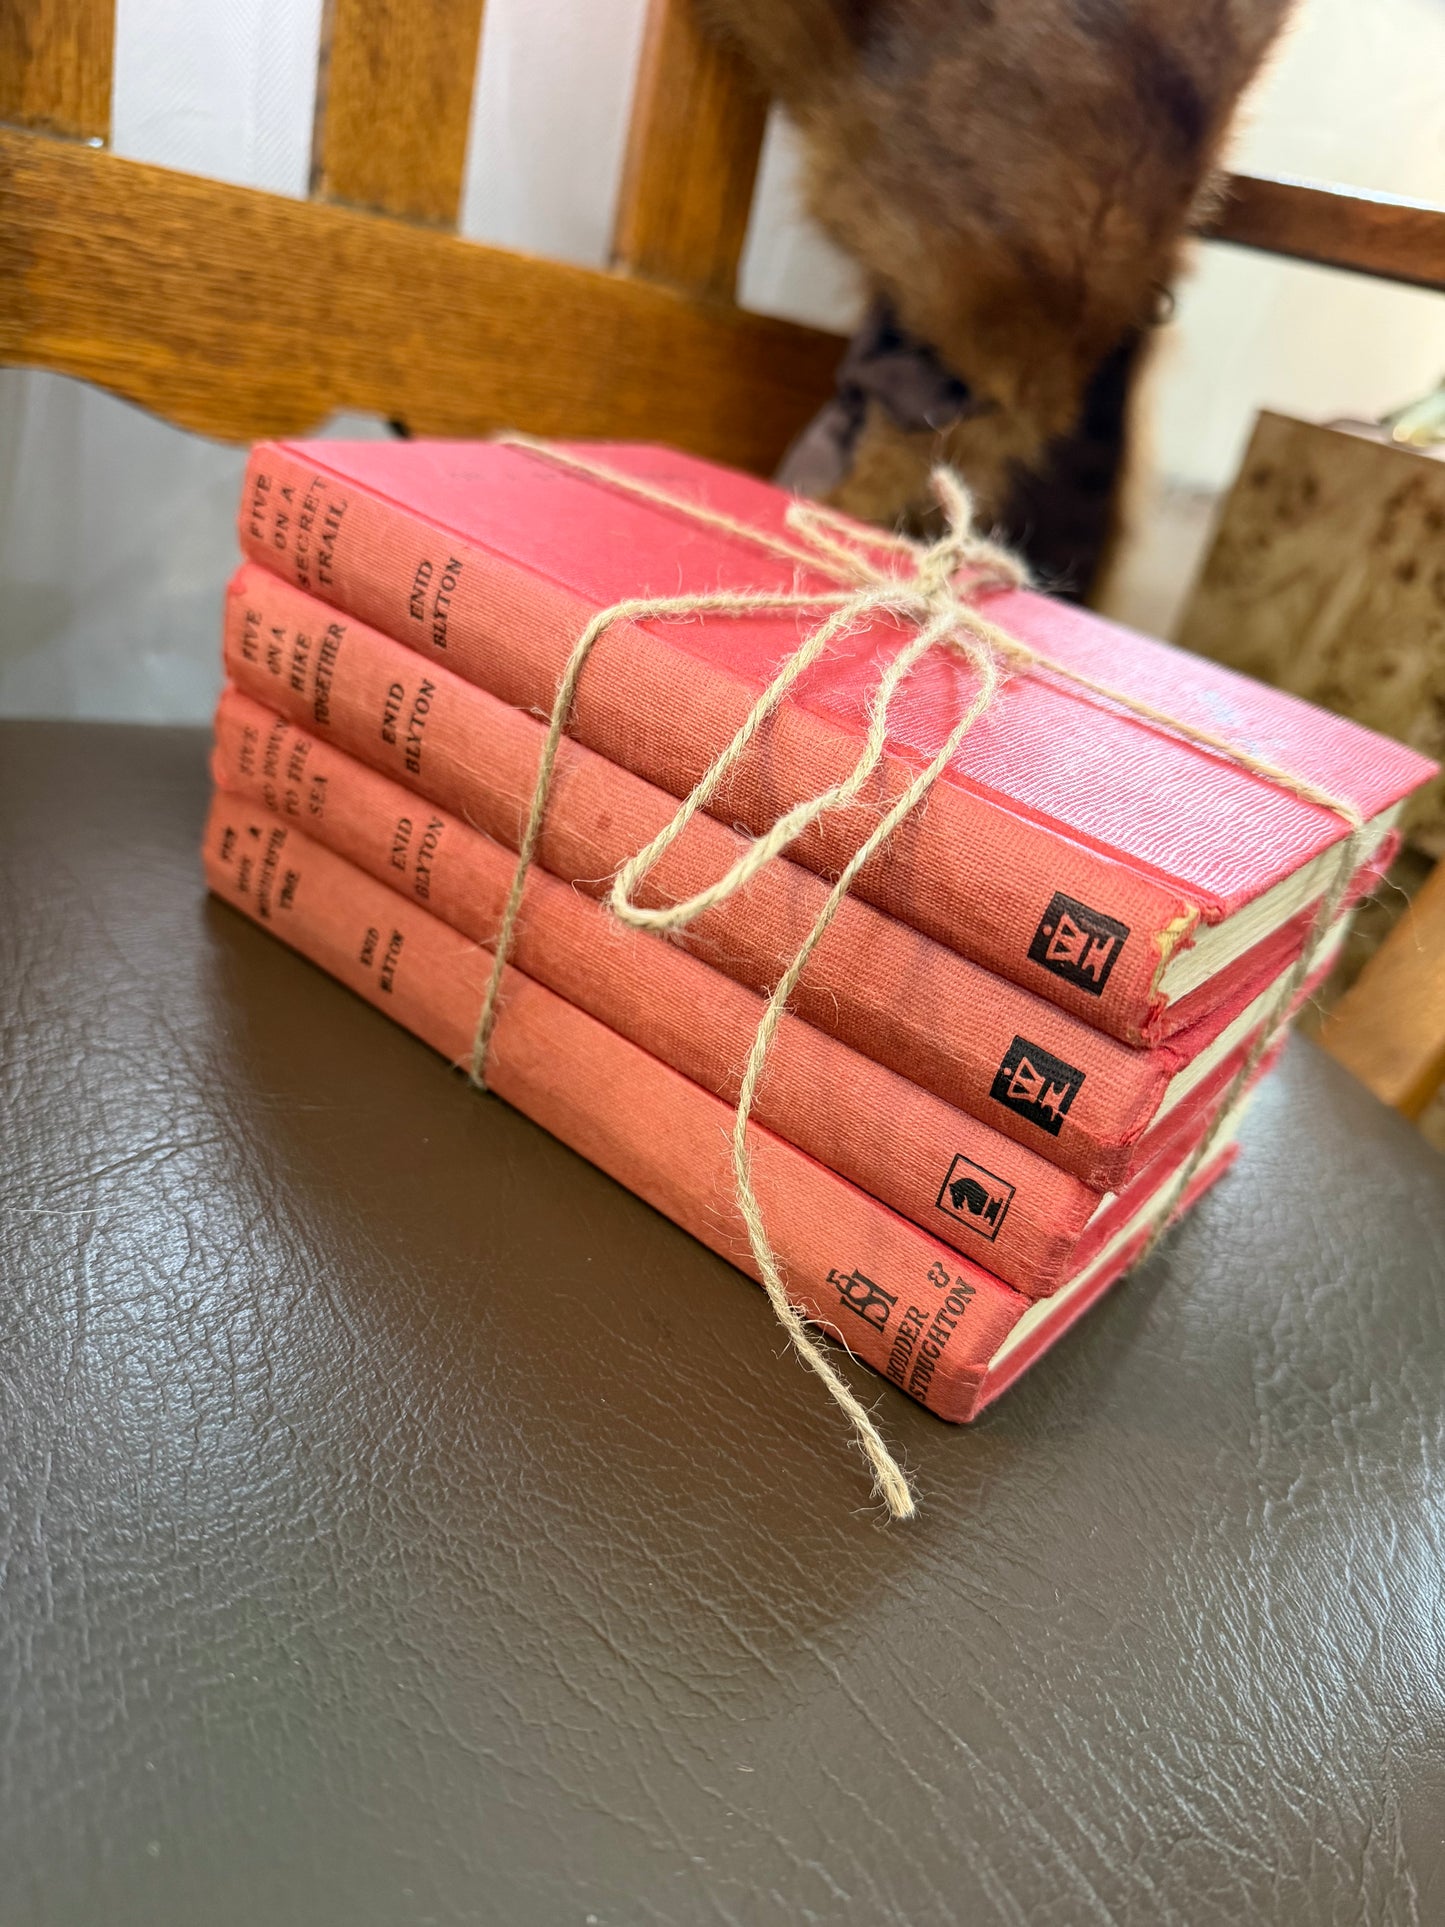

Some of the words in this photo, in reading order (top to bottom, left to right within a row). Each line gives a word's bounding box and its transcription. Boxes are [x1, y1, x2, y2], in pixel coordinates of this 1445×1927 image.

[250, 474, 271, 540] FIVE
[281, 485, 296, 504] A
[274, 512, 290, 550] ON
[296, 475, 328, 588] SECRET
[318, 498, 348, 586] TRAIL
[409, 559, 434, 623] ENID
[432, 556, 464, 650] BLYTON
[242, 609, 262, 662] FIVE
[266, 643, 281, 676] ON
[290, 632, 312, 693] HIKE
[313, 623, 347, 726] TOGETHER
[381, 681, 405, 747] ENID
[404, 677, 437, 777] BLYTON
[390, 816, 414, 873] ENID
[414, 815, 446, 901] BLYTON
[359, 926, 380, 969] ENID
[379, 928, 405, 995] BLYTON
[886, 1305, 930, 1387] HODDER
[926, 1260, 951, 1289] &
[908, 1275, 977, 1402] STOUGHTON
